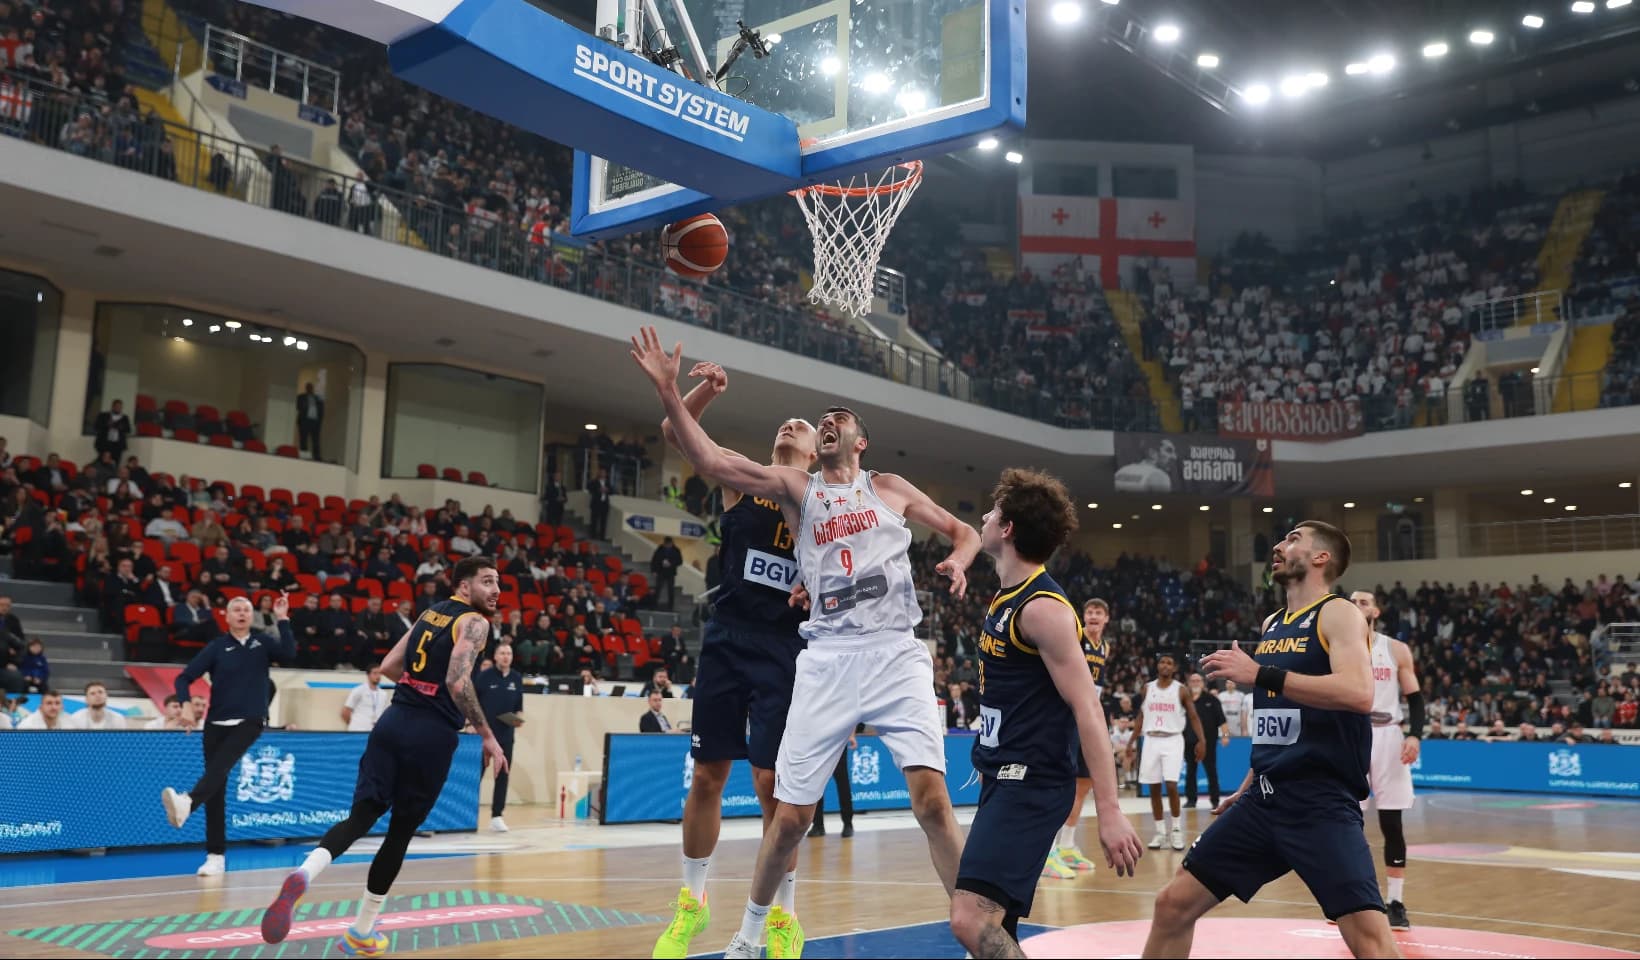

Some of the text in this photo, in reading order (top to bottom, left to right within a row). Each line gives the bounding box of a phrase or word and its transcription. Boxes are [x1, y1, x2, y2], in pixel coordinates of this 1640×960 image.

[575, 44, 750, 135] SPORT SYSTEM
[750, 556, 799, 586] BGV
[840, 549, 853, 577] 9
[412, 629, 433, 673] 5
[1257, 716, 1293, 738] BGV
